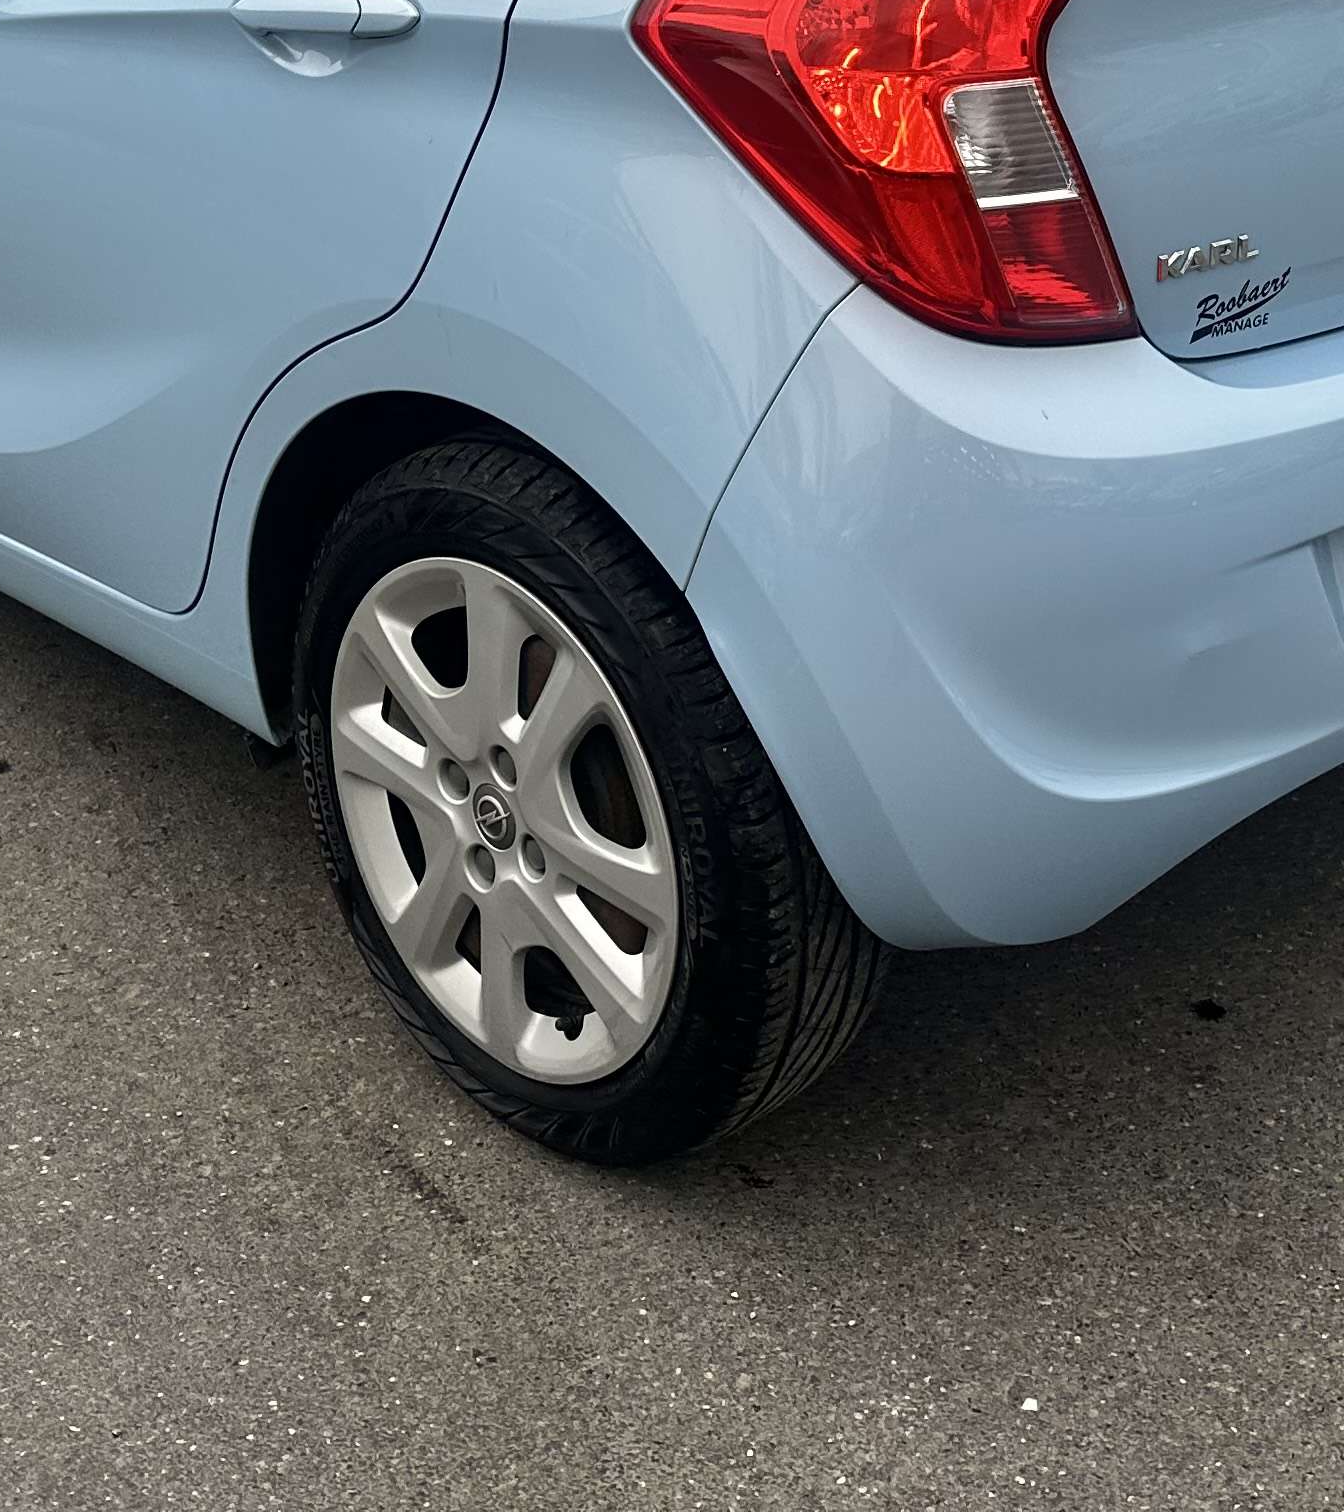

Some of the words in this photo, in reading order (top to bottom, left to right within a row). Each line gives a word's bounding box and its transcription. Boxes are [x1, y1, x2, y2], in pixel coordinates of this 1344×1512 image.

[1157, 234, 1260, 281] KARL
[1196, 266, 1292, 327] Roobaert
[1211, 312, 1270, 338] MANAGE
